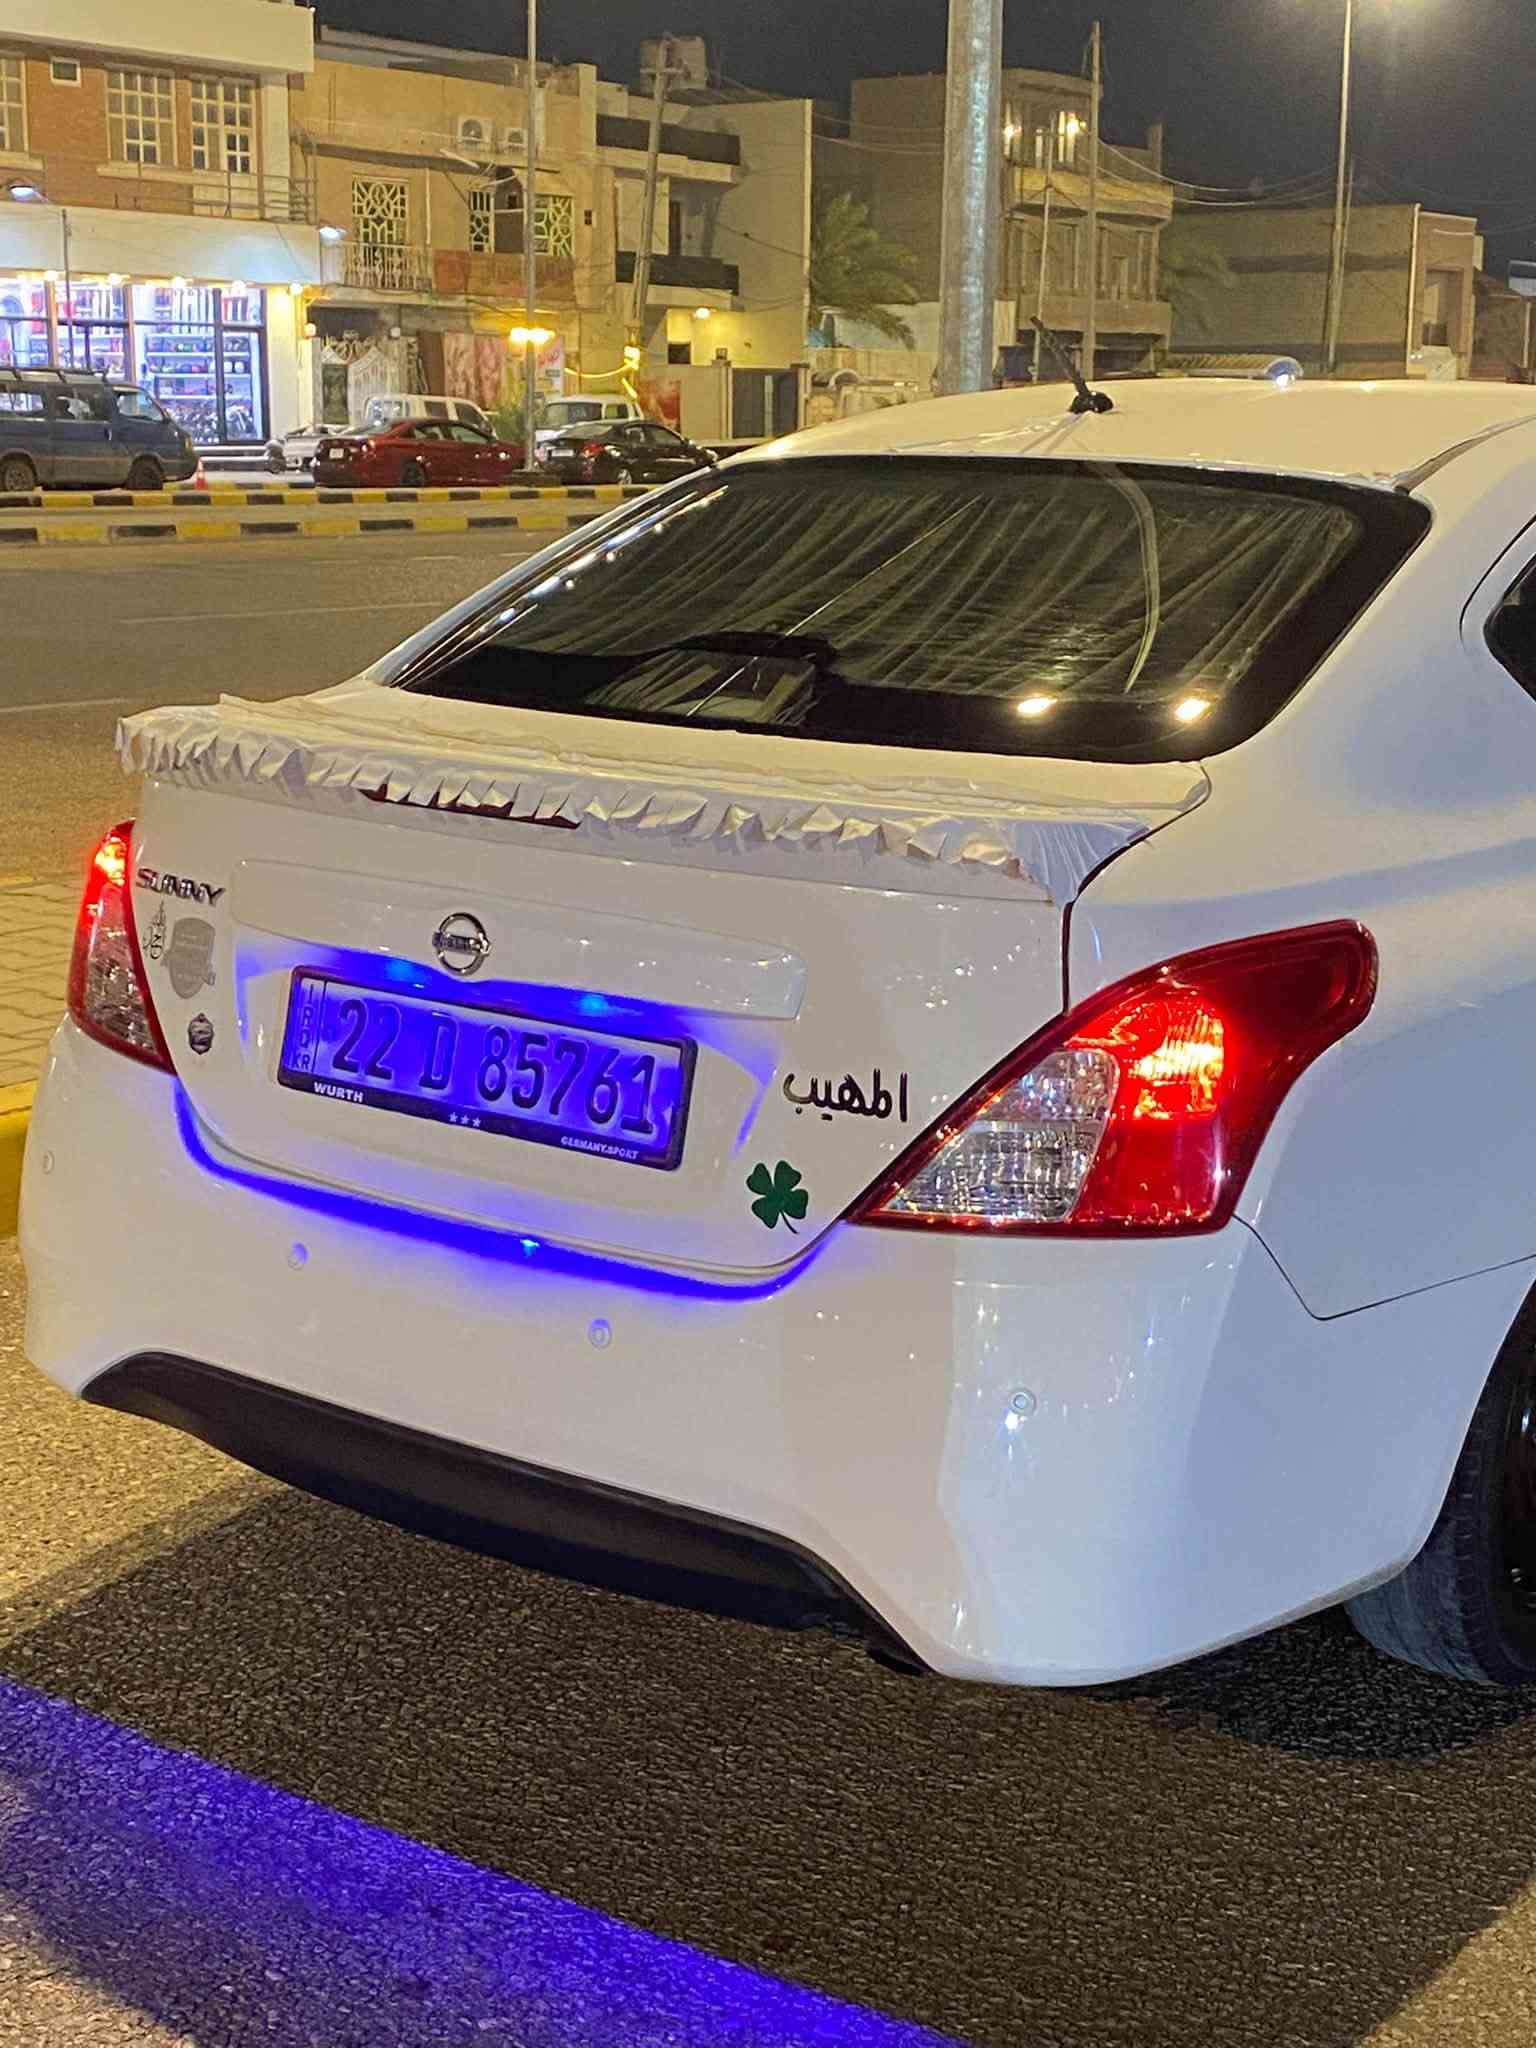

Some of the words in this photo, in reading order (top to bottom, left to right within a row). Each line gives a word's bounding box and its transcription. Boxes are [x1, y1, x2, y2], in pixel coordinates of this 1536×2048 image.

[135, 868, 225, 907] SUNNY
[332, 999, 402, 1080] 22
[419, 1010, 459, 1091] D
[477, 1024, 656, 1135] 85761
[313, 1081, 364, 1102] WURTH
[783, 1068, 908, 1122] المهيب
